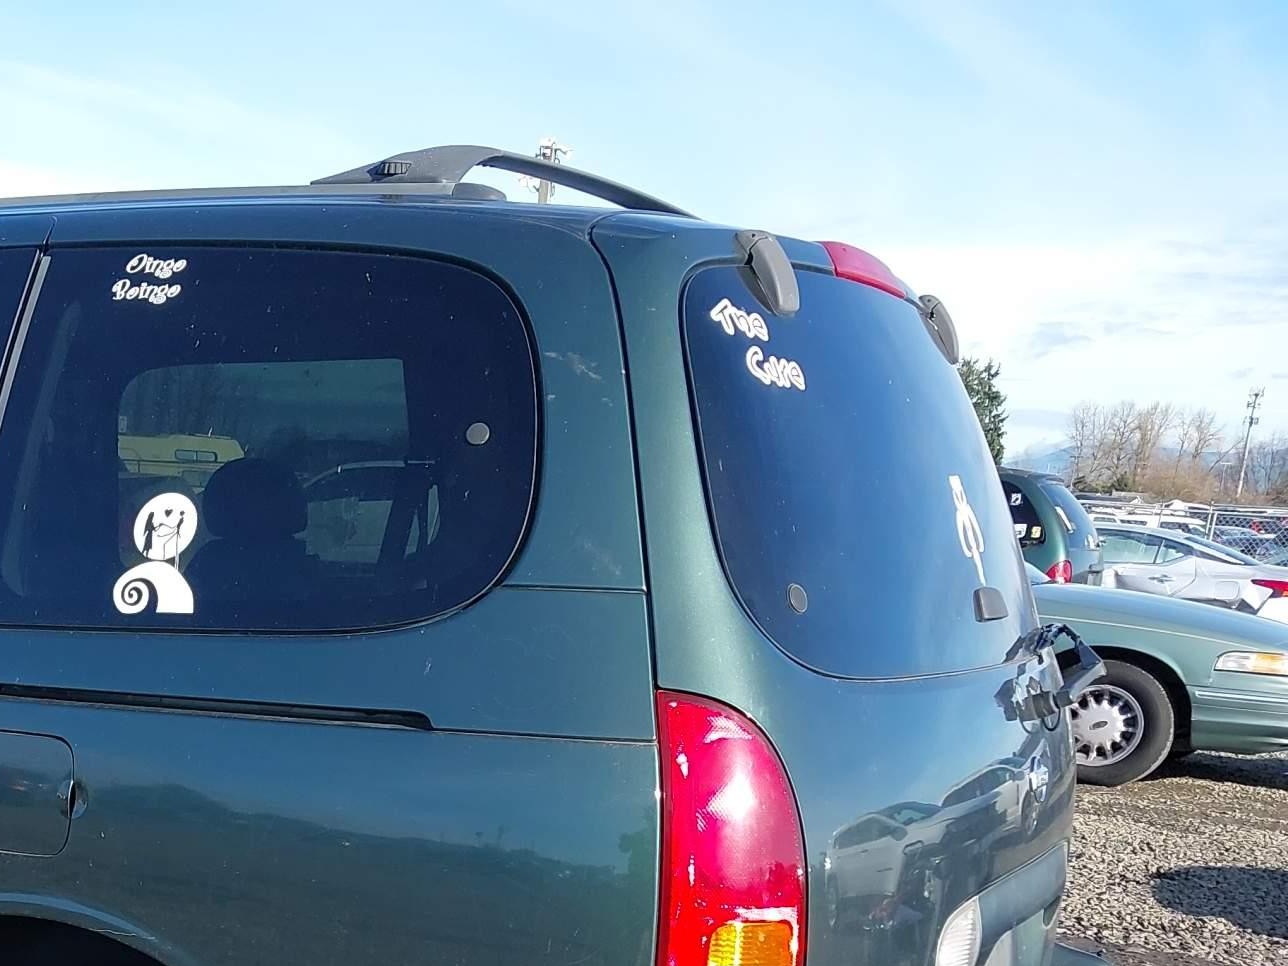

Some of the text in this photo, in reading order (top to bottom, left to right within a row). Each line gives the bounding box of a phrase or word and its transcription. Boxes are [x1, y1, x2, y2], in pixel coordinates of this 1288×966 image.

[125, 253, 187, 279] Oingo
[111, 278, 181, 305] Boingo
[710, 298, 769, 341] The
[746, 345, 806, 390] Cure
